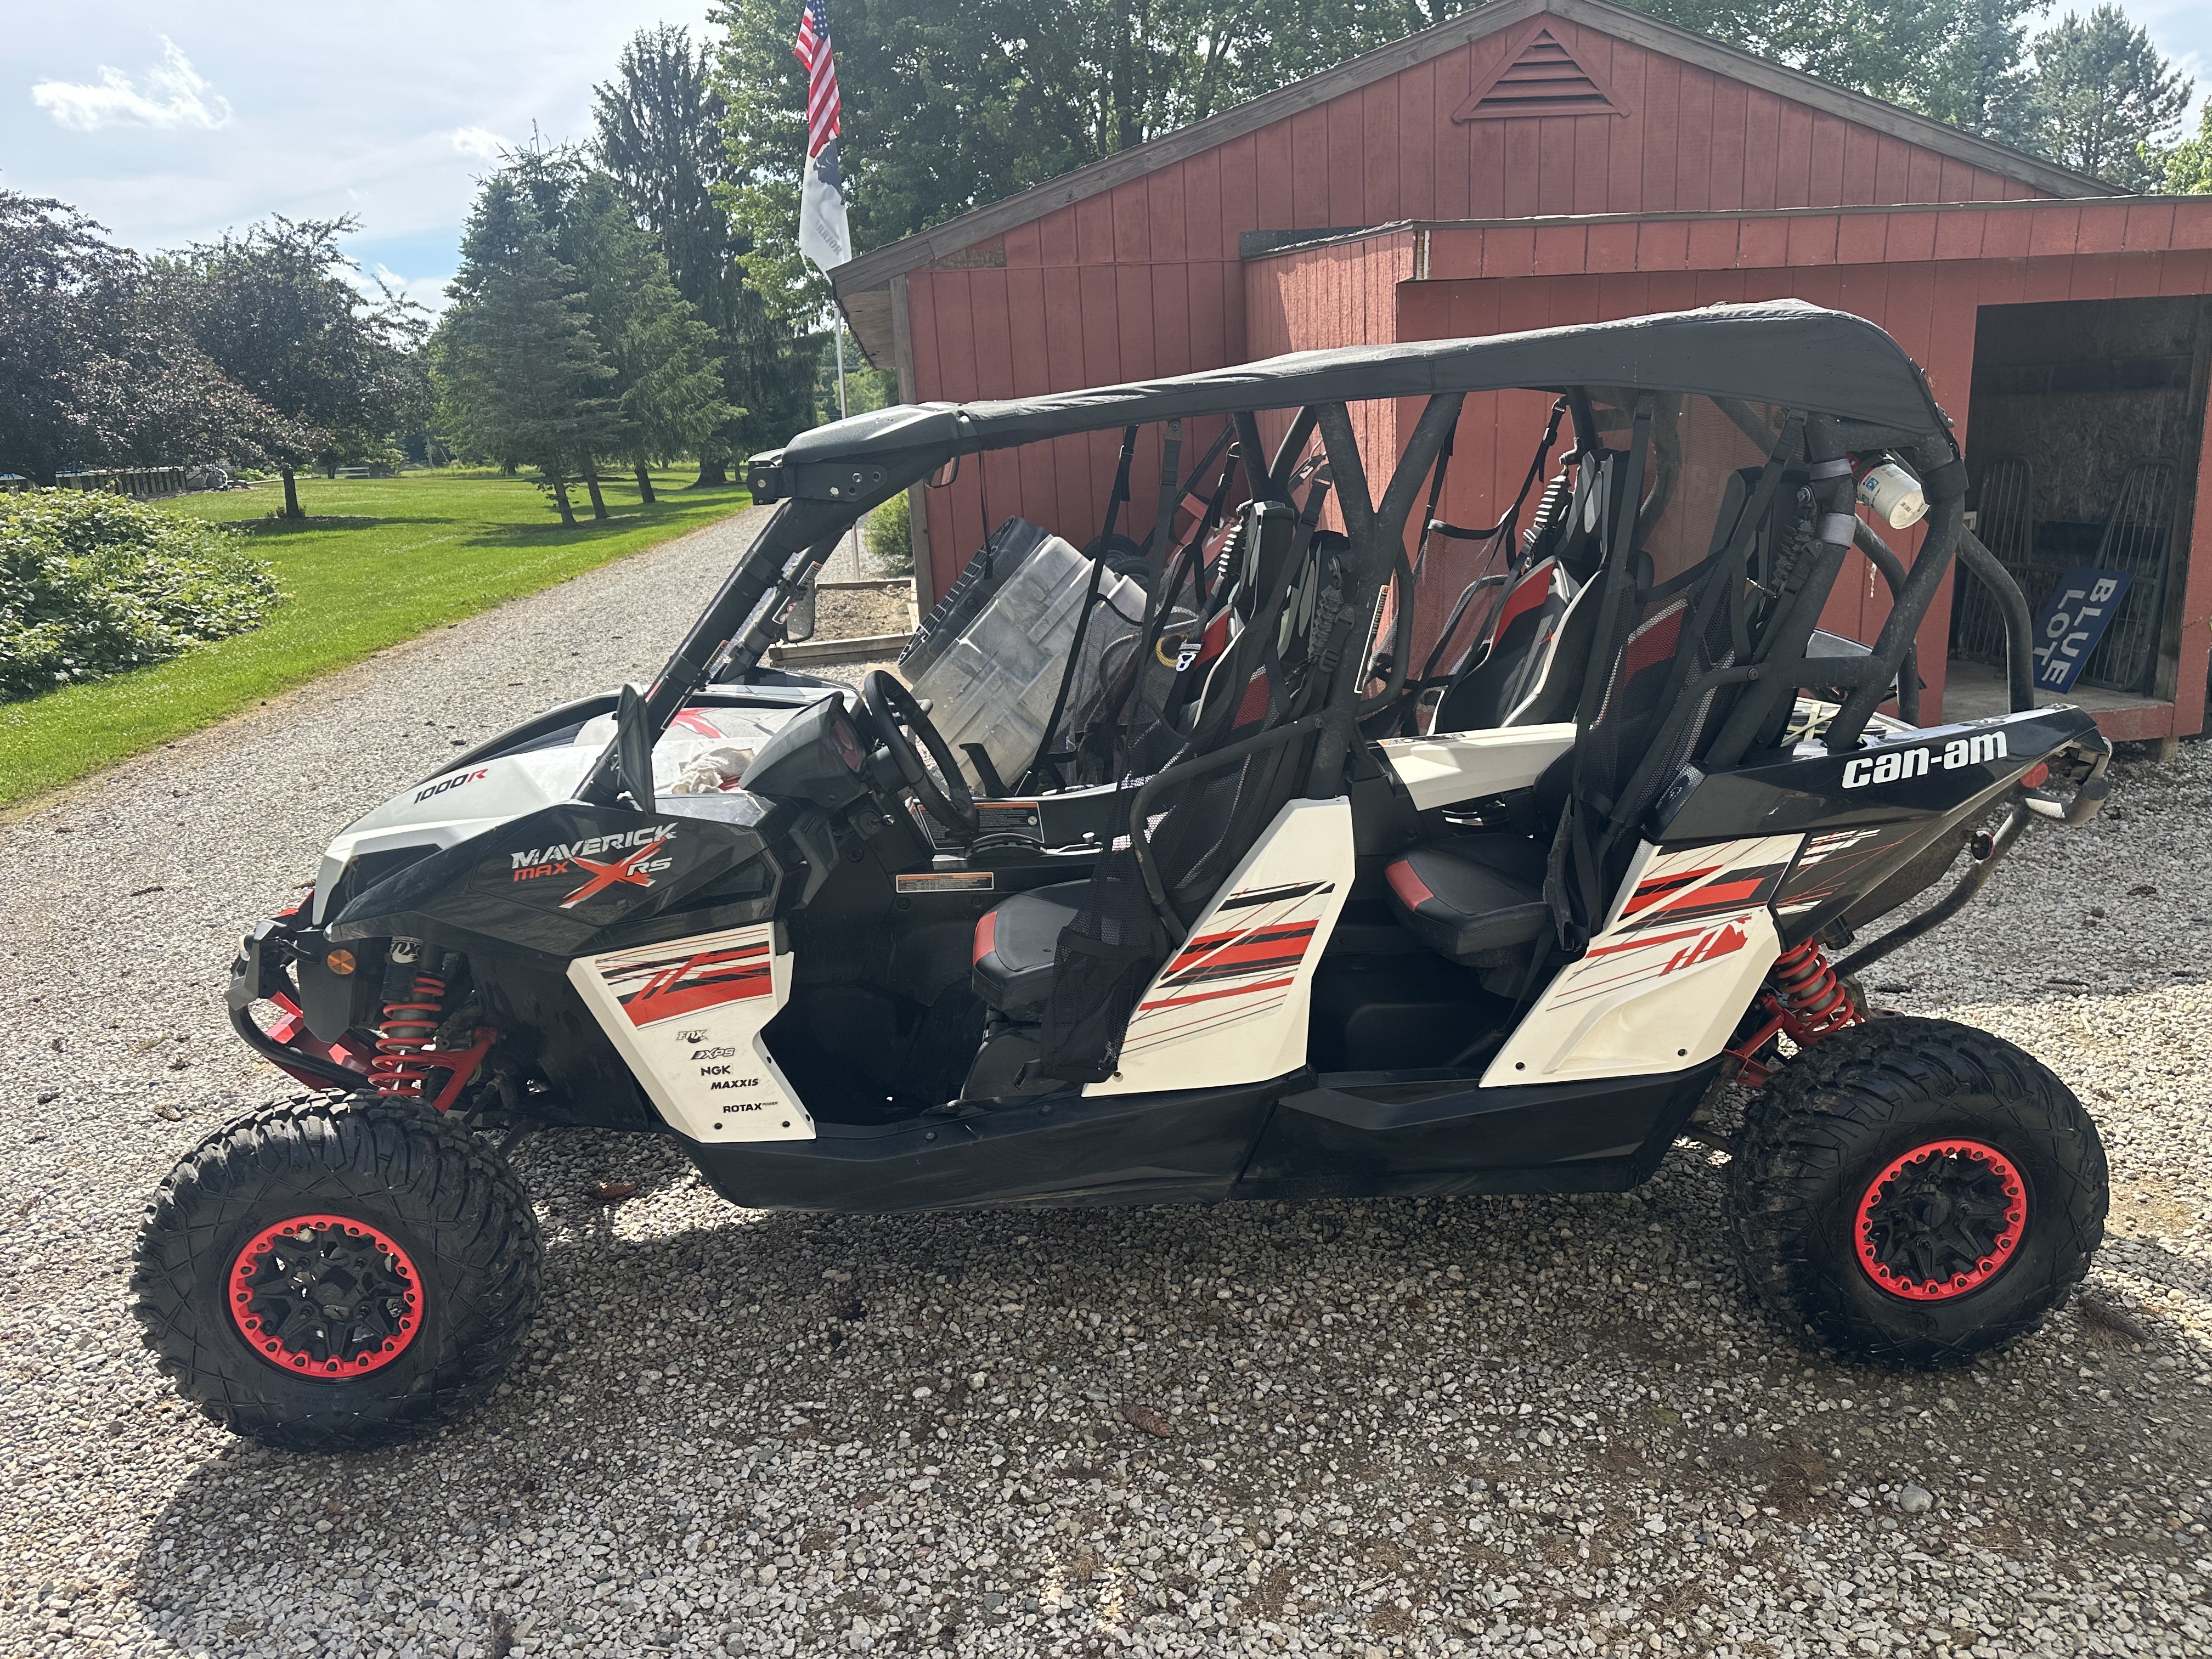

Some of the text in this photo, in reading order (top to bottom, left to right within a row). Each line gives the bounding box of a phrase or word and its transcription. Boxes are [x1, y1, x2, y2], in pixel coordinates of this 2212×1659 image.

[2033, 589, 2086, 665] LOT
[2041, 578, 2118, 684] BLUE
[1842, 731, 2007, 788] can-am
[413, 769, 488, 804] 1000R
[511, 822, 679, 869] MAVERICK
[676, 1029, 708, 1042] FOX
[702, 1047, 736, 1059] XPS
[701, 1065, 731, 1076] NGK
[710, 1079, 759, 1090] MAXXIS
[723, 1103, 762, 1113] ROTAX
